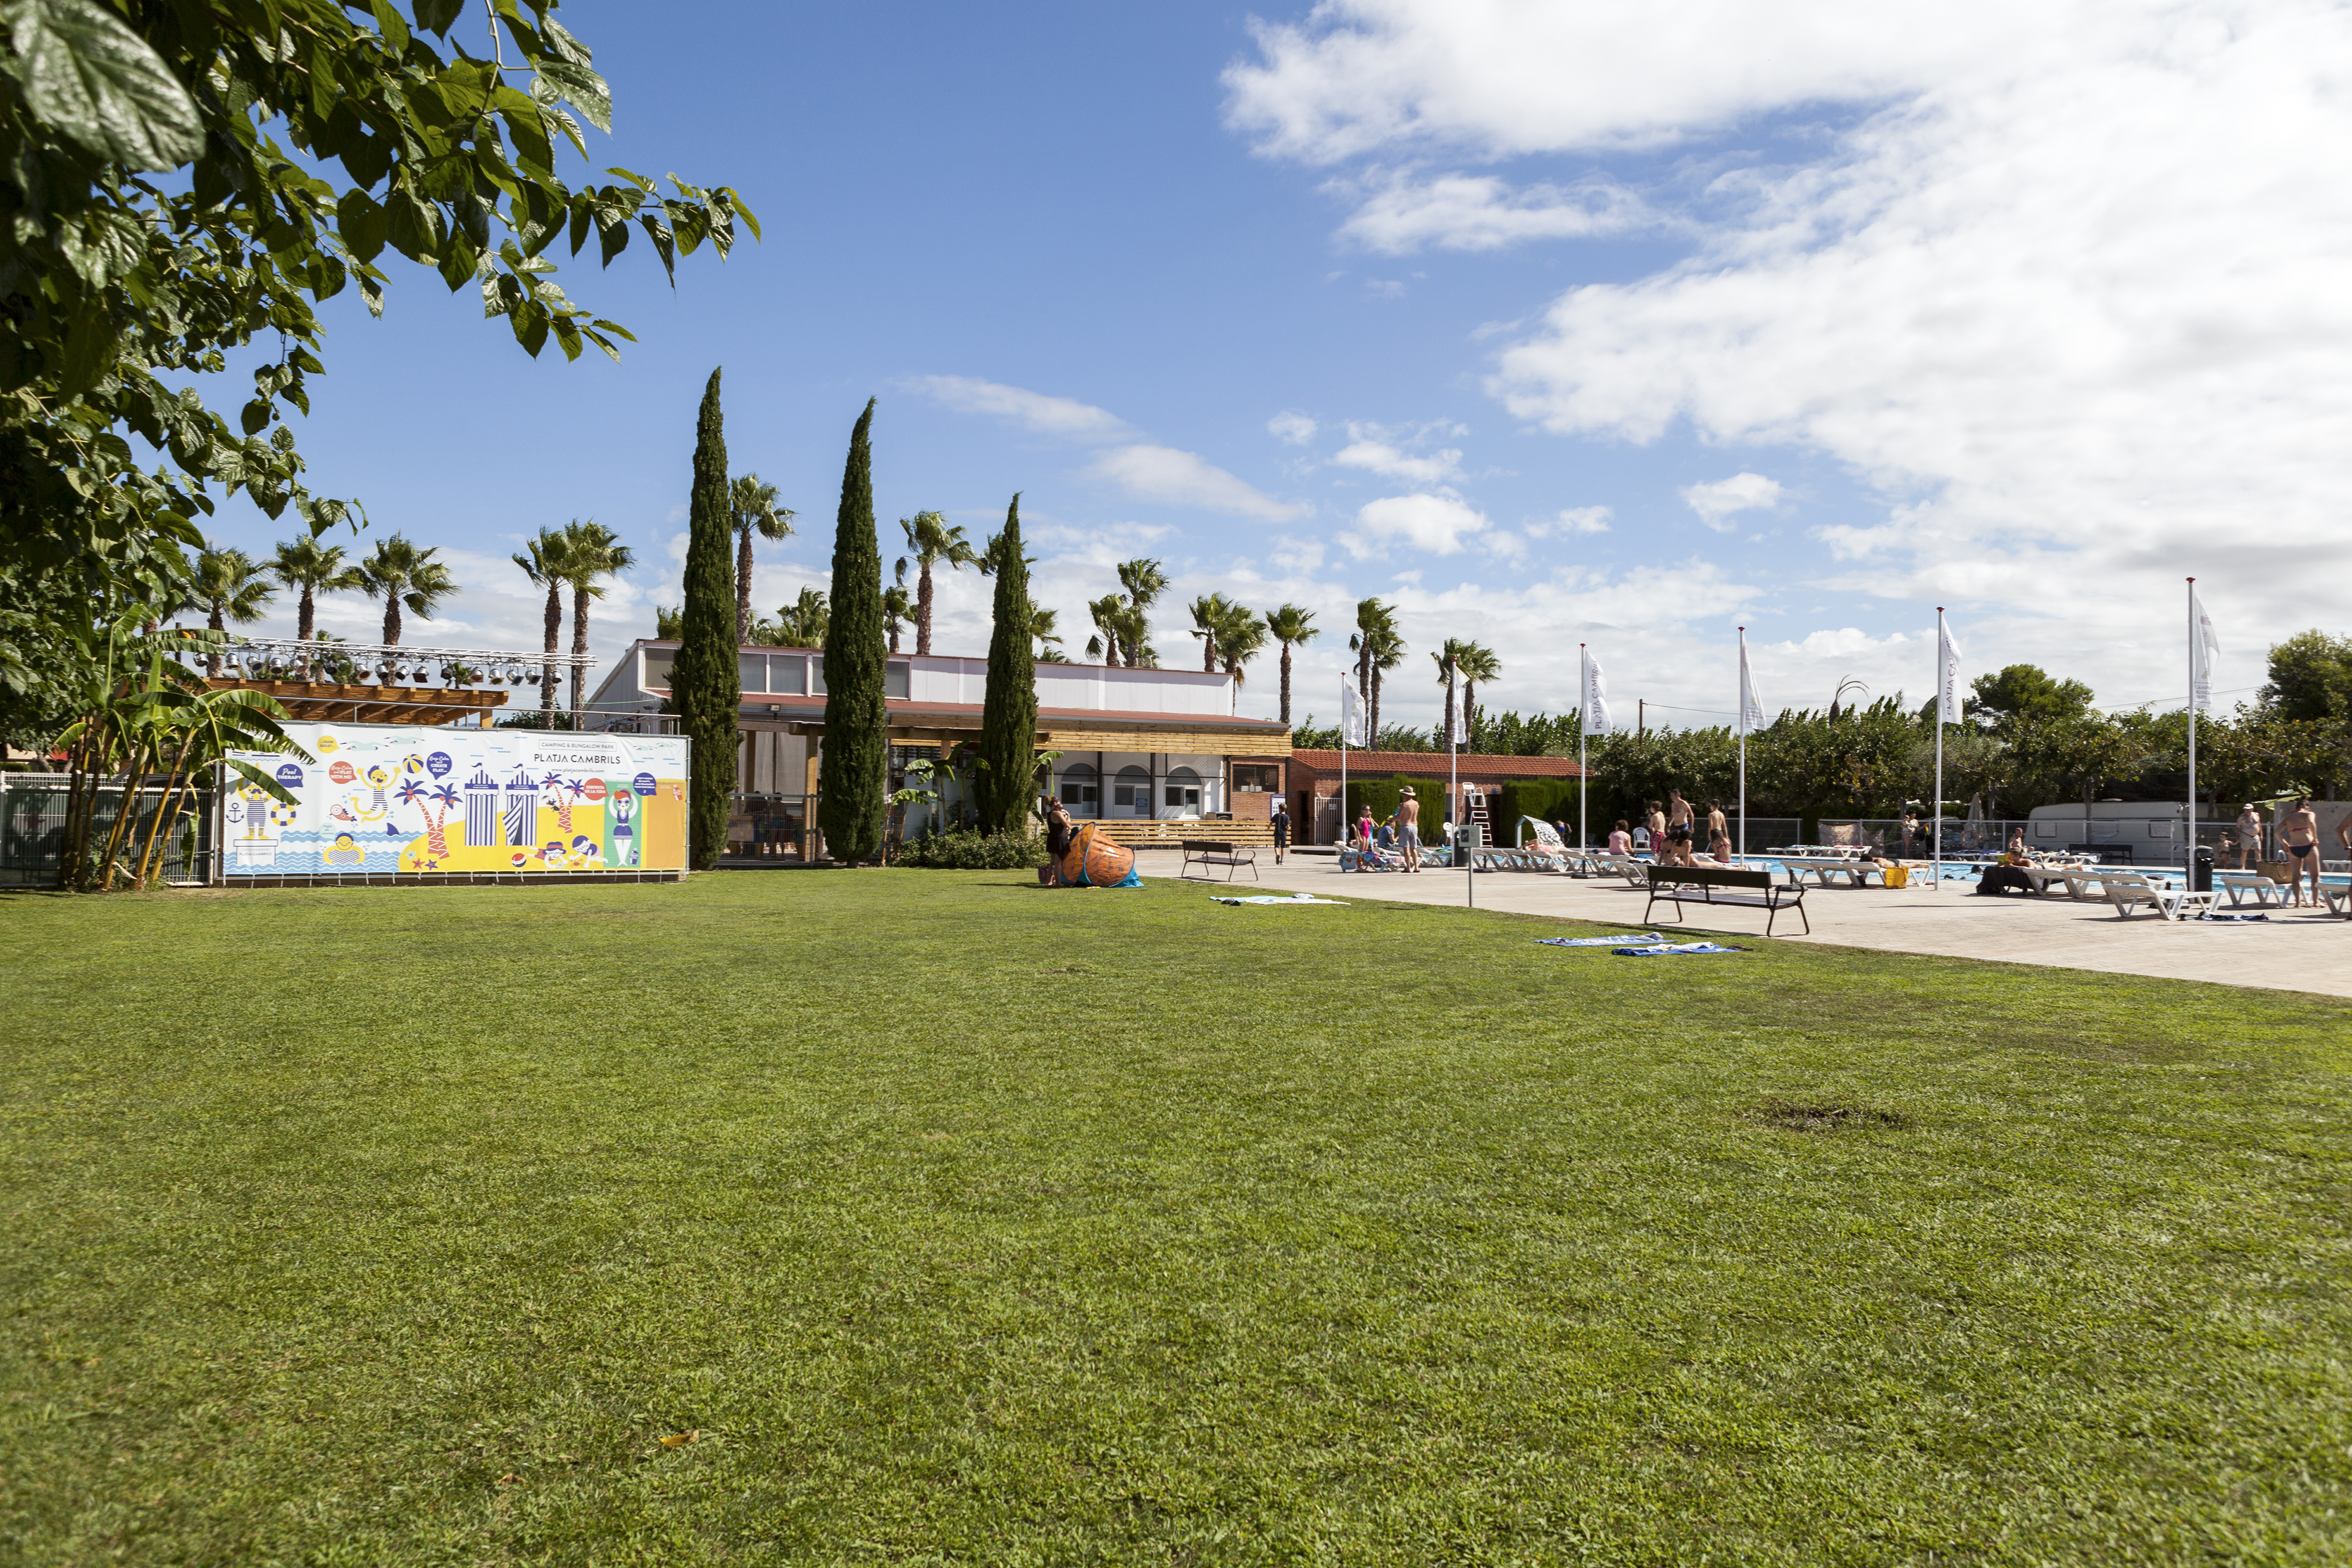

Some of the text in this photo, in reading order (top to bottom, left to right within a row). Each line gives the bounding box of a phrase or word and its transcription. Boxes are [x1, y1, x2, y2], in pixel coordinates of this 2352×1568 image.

[1593, 700, 1602, 729] PLATJA
[534, 754, 620, 764] PLATJA CAMBRILS
